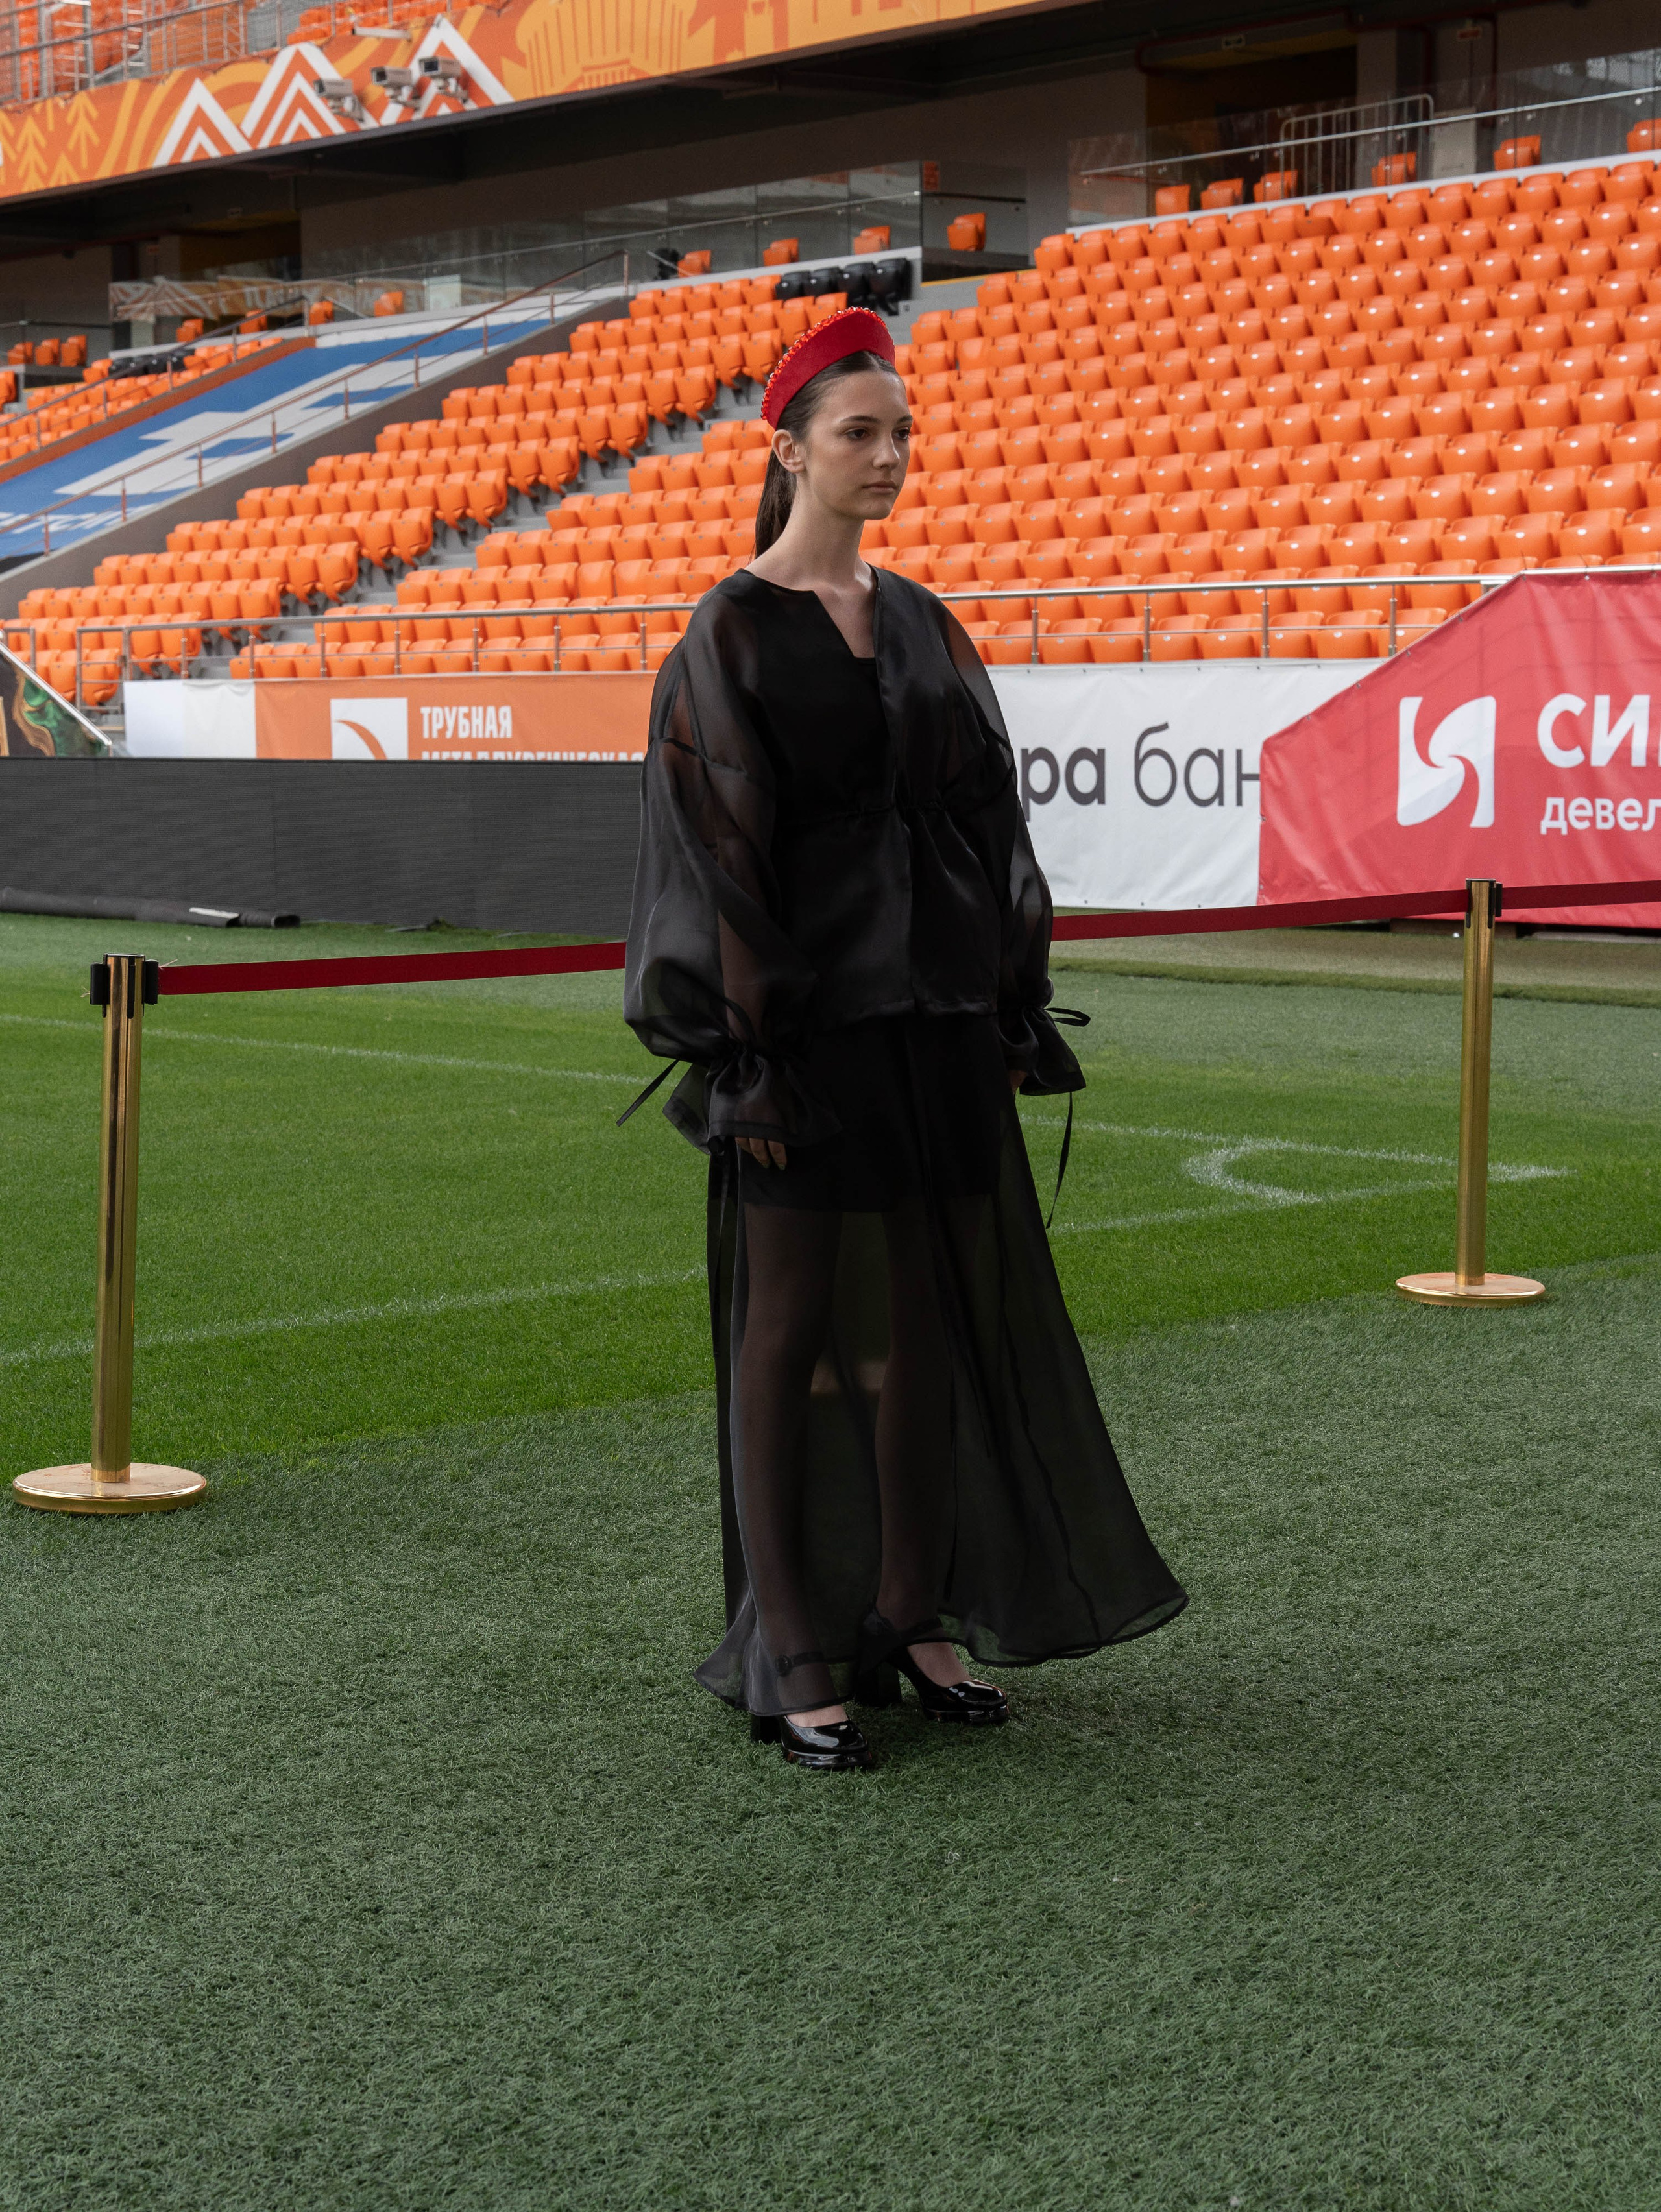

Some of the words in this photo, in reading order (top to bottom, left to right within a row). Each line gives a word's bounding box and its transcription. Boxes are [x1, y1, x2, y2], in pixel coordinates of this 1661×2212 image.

[420, 706, 513, 739] ТРУБНАЯ
[1536, 693, 1661, 769] СИ
[1021, 747, 1106, 822] ра
